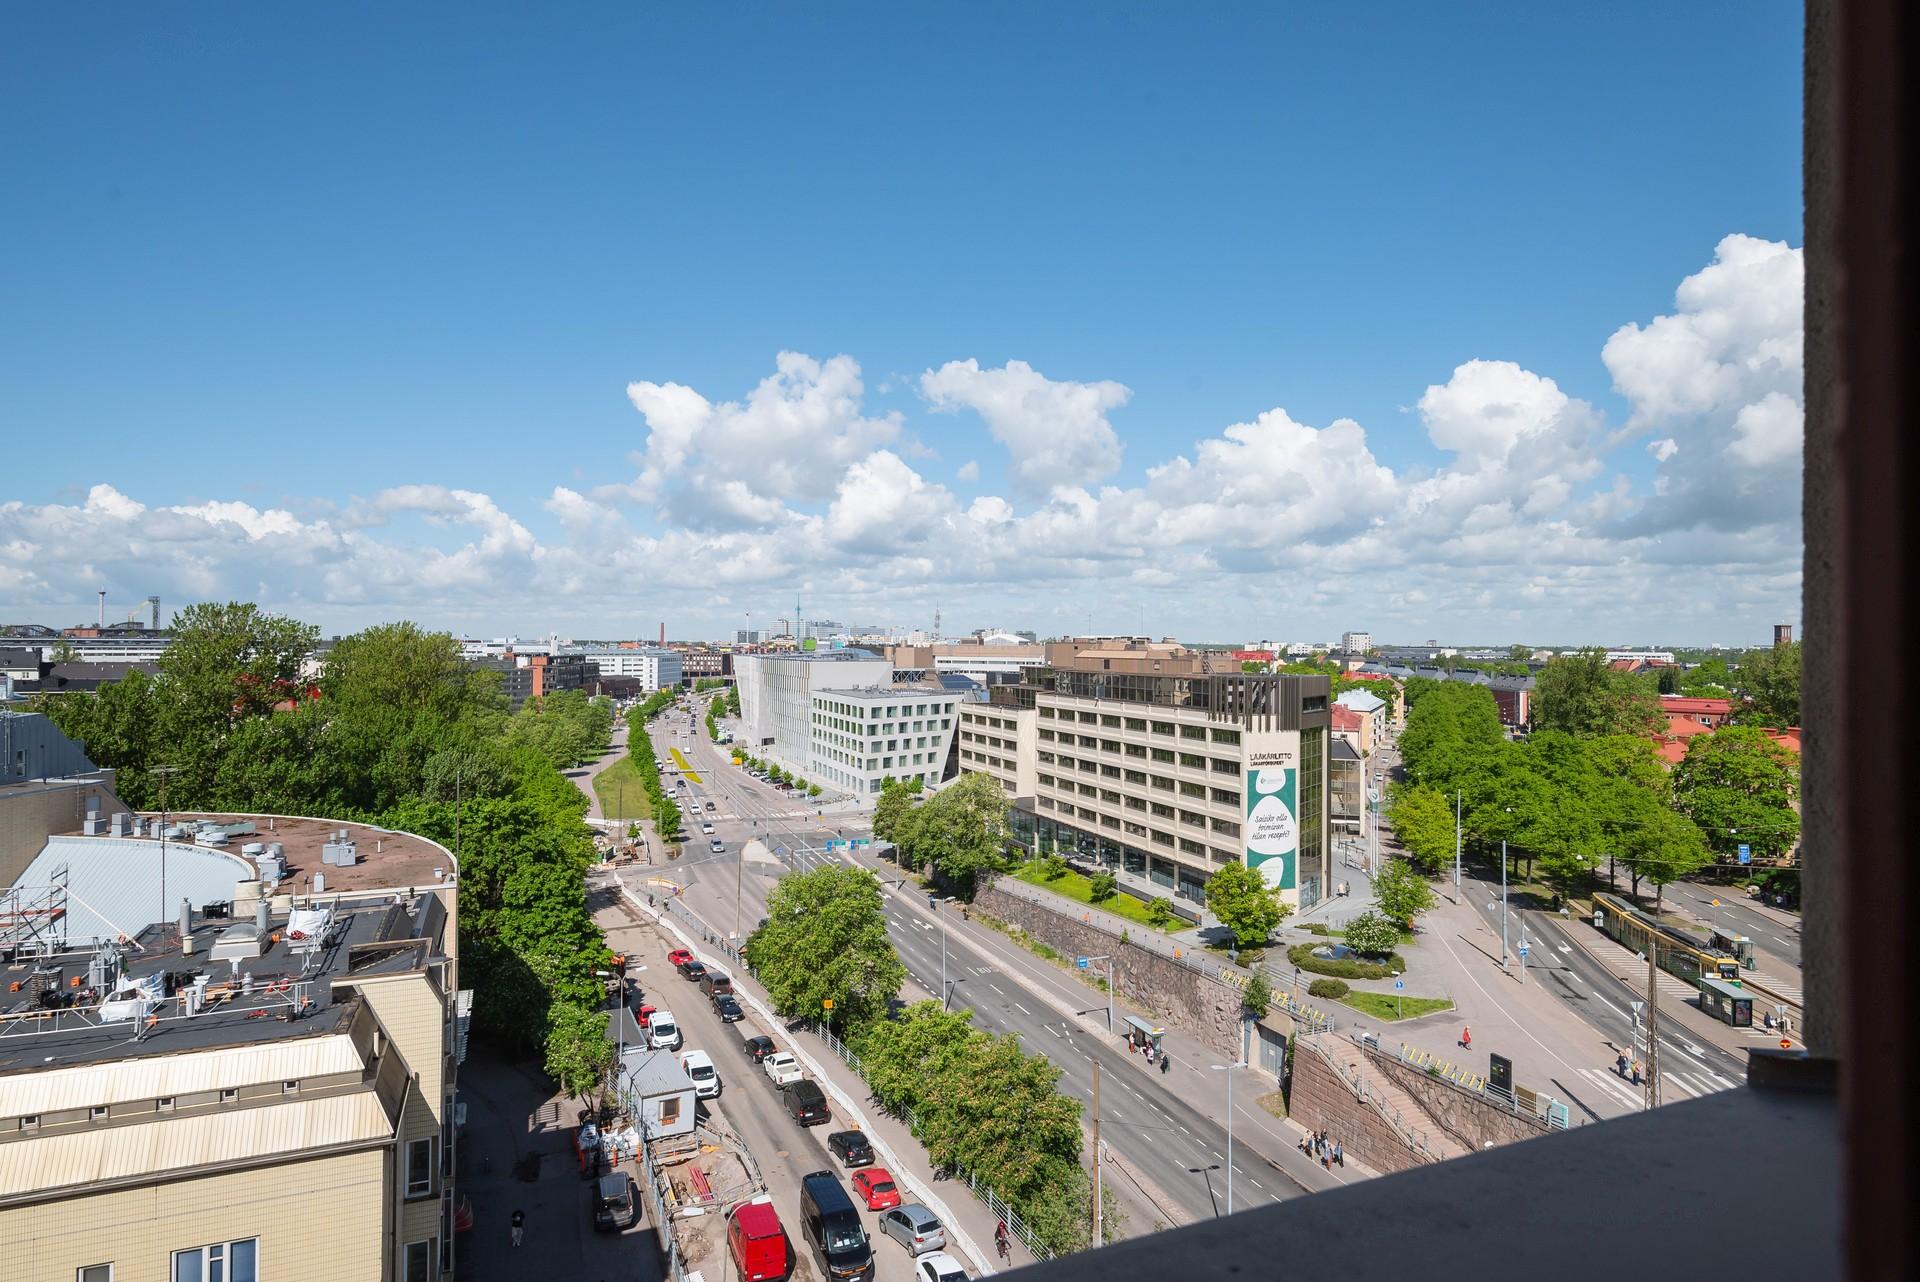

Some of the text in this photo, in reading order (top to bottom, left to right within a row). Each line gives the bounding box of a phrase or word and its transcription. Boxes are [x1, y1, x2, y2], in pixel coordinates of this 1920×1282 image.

[1255, 813, 1288, 823] Saisiko olla
[1252, 832, 1266, 840] tilan
